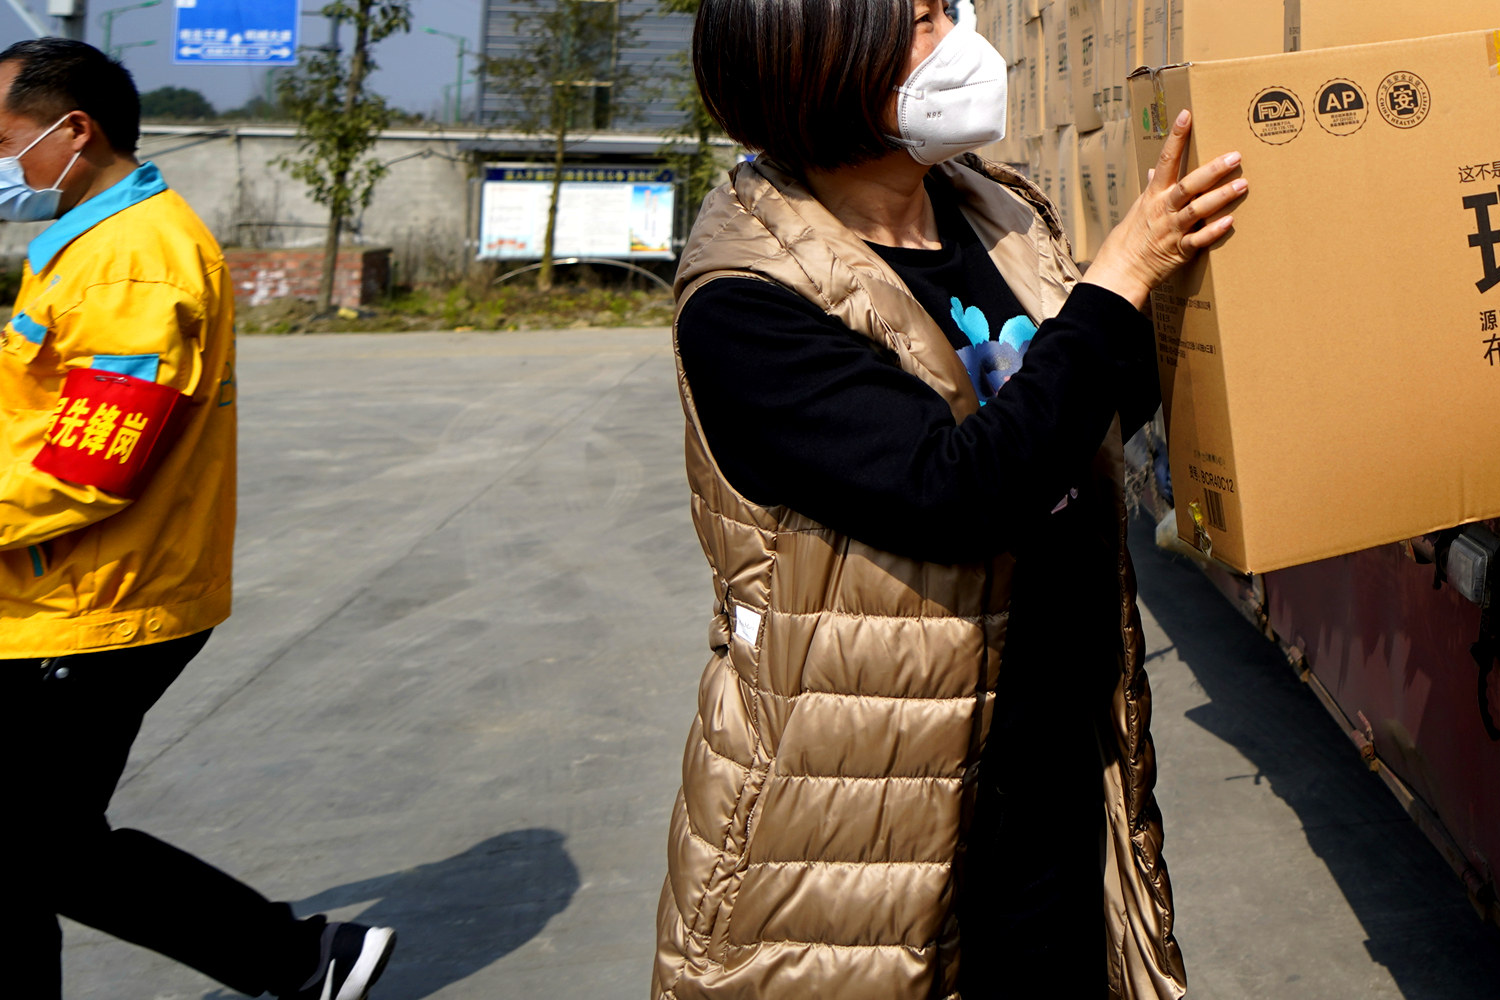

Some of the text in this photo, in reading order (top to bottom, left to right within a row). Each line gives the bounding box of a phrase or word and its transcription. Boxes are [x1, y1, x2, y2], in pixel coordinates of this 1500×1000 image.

[1257, 99, 1297, 120] FDA
[1325, 90, 1356, 112] AP
[1390, 117, 1417, 127] HEALTH
[1200, 470, 1235, 494] BCR40C12
